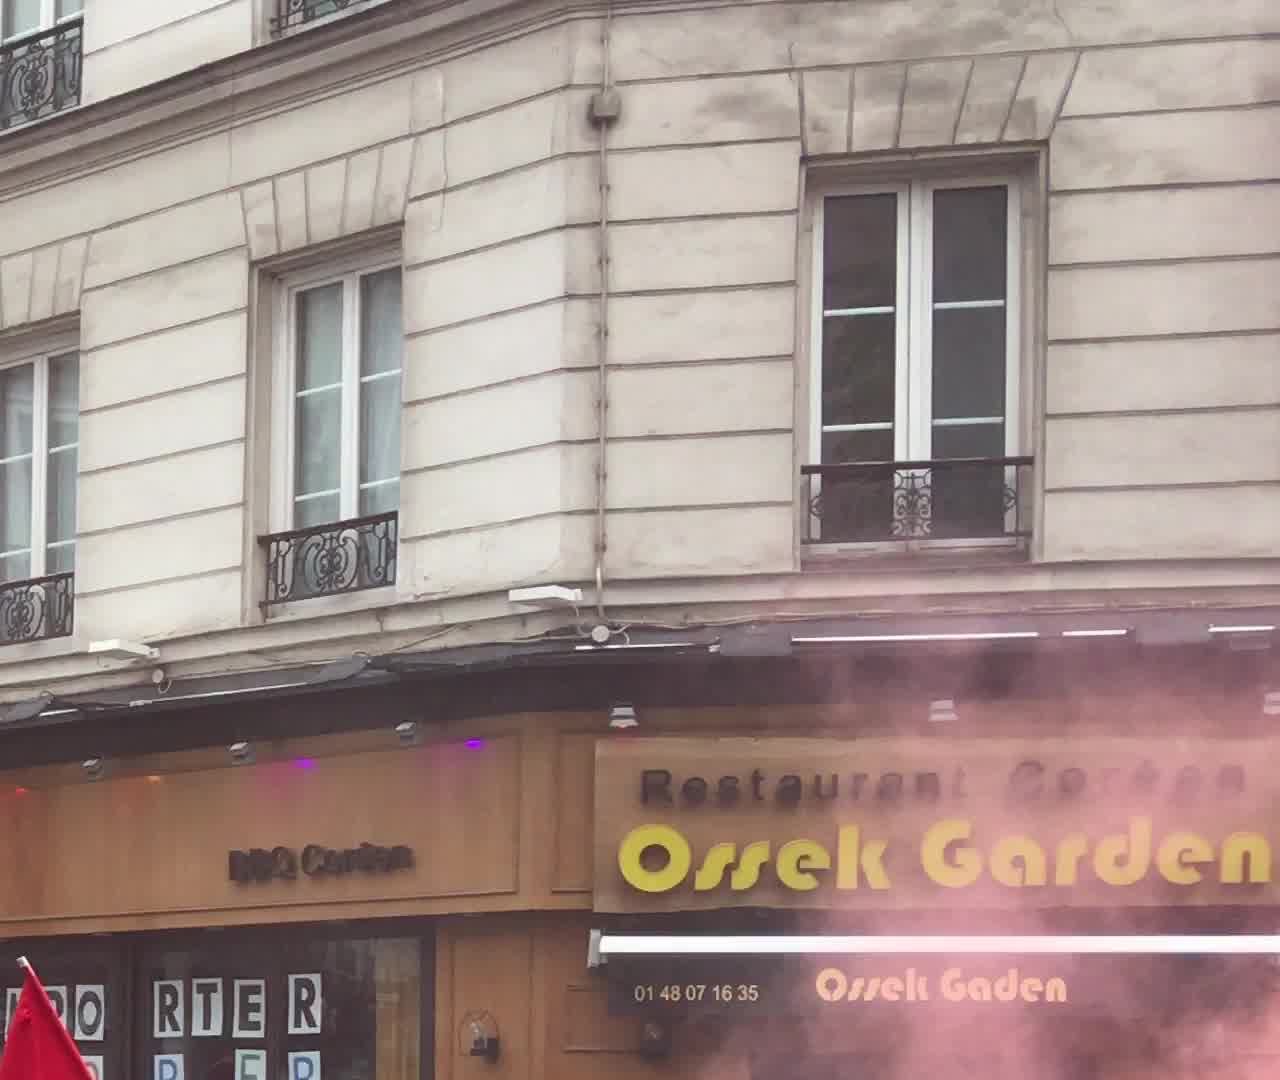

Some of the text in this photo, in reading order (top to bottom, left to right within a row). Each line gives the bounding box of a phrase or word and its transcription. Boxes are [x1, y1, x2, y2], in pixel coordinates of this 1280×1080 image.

[641, 766, 966, 804] Restaurant
[618, 815, 1272, 892] Ossek Garden
[634, 983, 759, 1001] 01 48 07 16 35
[816, 968, 1068, 1003] Ossek Gaden
